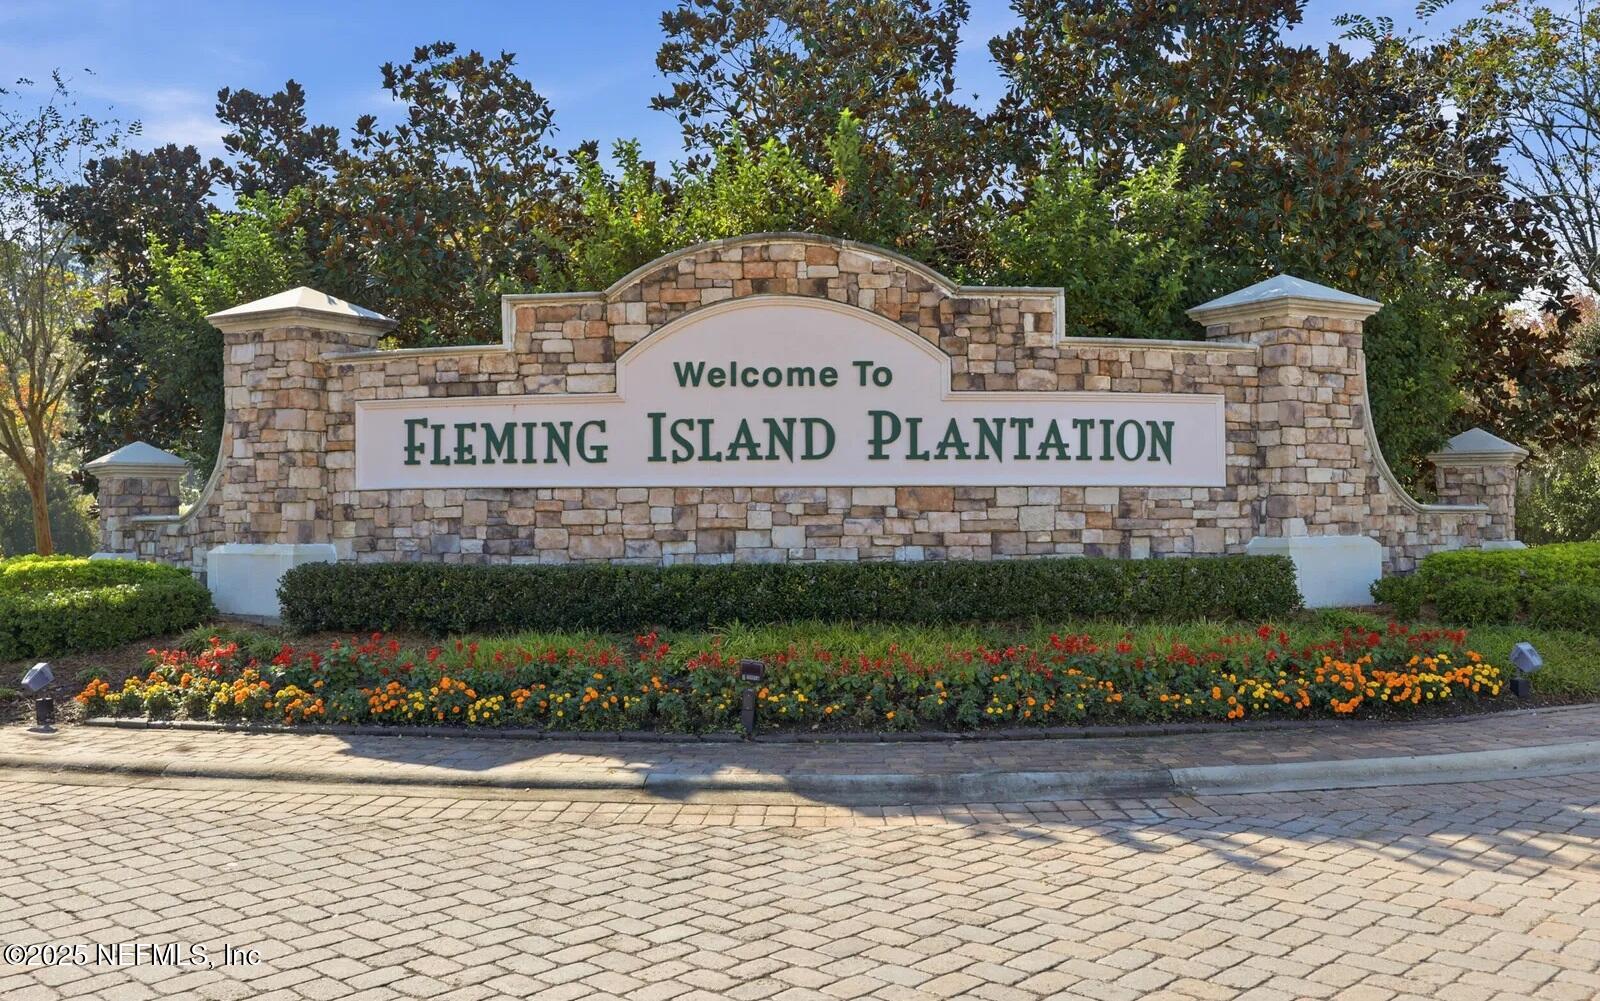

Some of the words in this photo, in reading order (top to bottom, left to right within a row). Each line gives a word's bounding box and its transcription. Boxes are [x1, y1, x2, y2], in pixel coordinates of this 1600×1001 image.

[673, 361, 839, 388] Welcome
[852, 361, 893, 388] To
[404, 418, 609, 467] FLEMING
[647, 412, 837, 465] ISLAND
[868, 410, 1176, 464] PLANTATION
